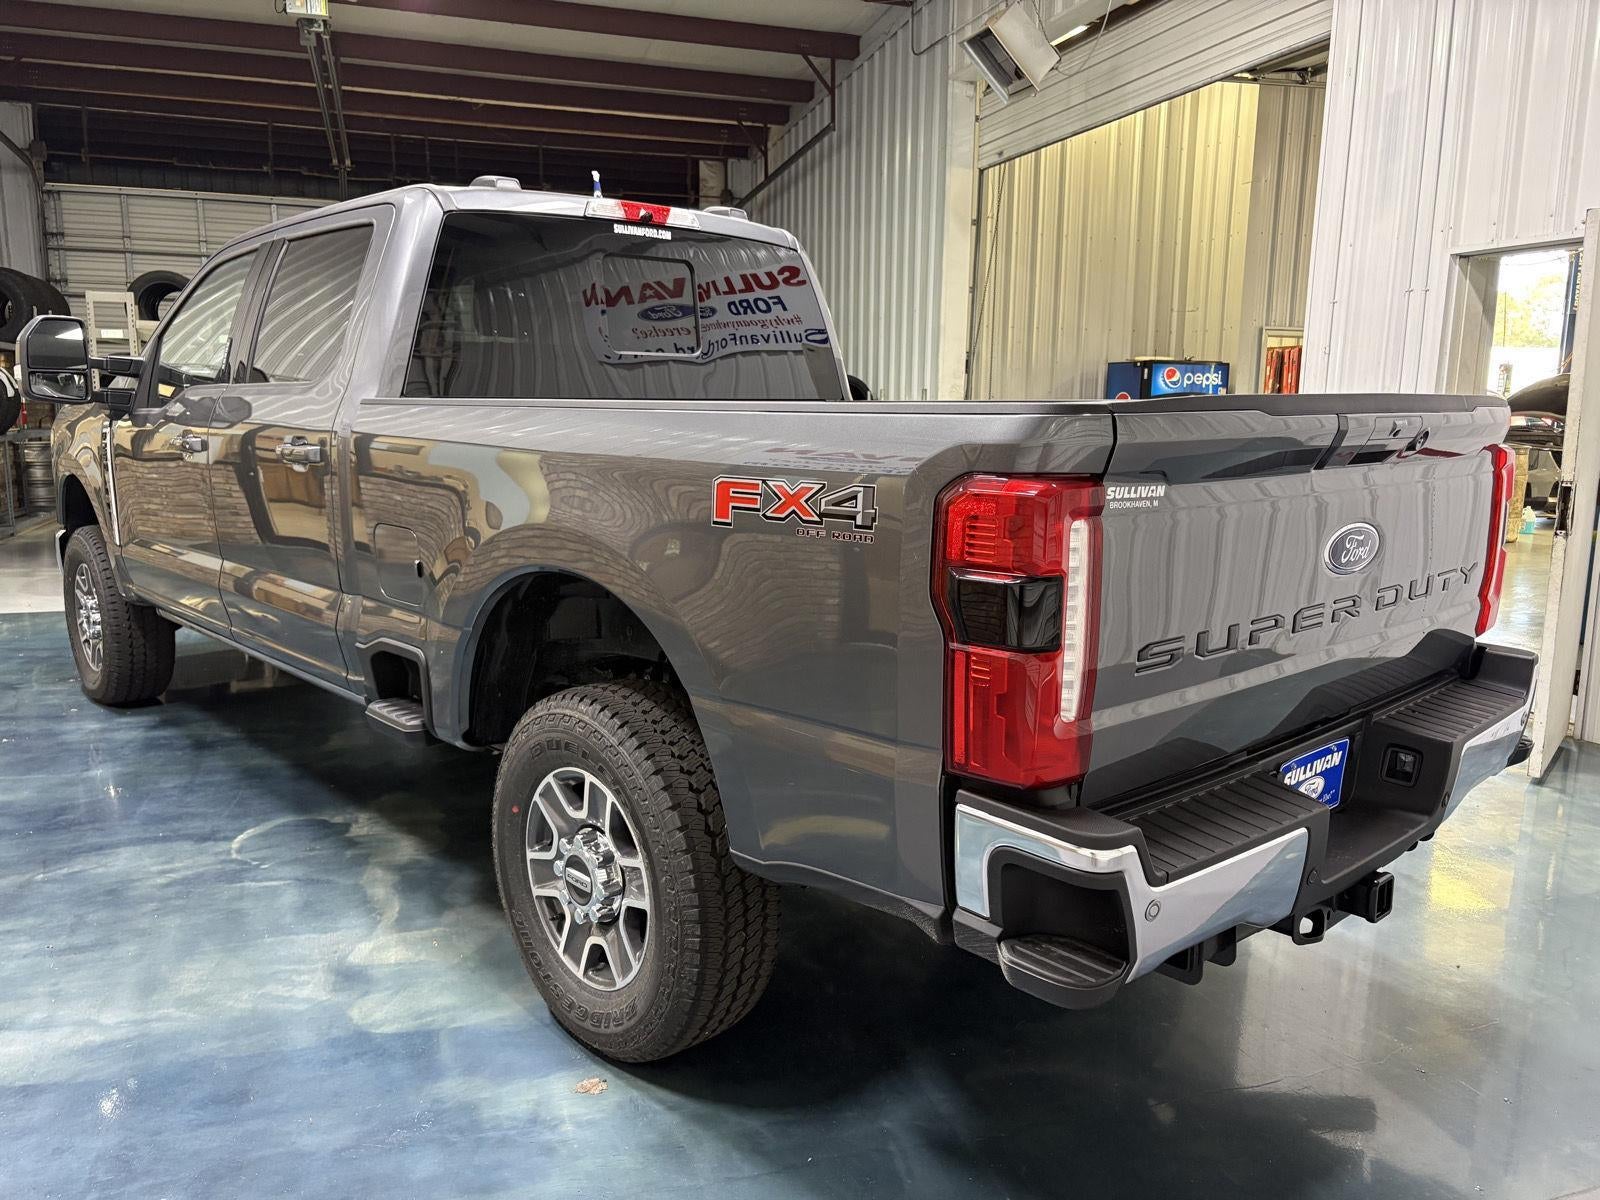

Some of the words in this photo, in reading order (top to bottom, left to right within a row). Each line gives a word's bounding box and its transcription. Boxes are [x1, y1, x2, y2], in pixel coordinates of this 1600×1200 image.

[613, 223, 672, 241] SULLIVANFORD.COM
[1183, 370, 1222, 388] pepsi
[1106, 485, 1166, 500] SULLIVAN
[712, 474, 878, 532] FX4
[1109, 500, 1153, 509] BROOKHAVEN,
[796, 528, 826, 539] OFF
[831, 530, 875, 544] ROAD
[1341, 535, 1372, 563] Ford
[1134, 594, 1361, 677] SUPER
[1375, 561, 1479, 612] DUTY
[1283, 751, 1343, 786] SULLIVAN
[567, 873, 588, 888] FORD
